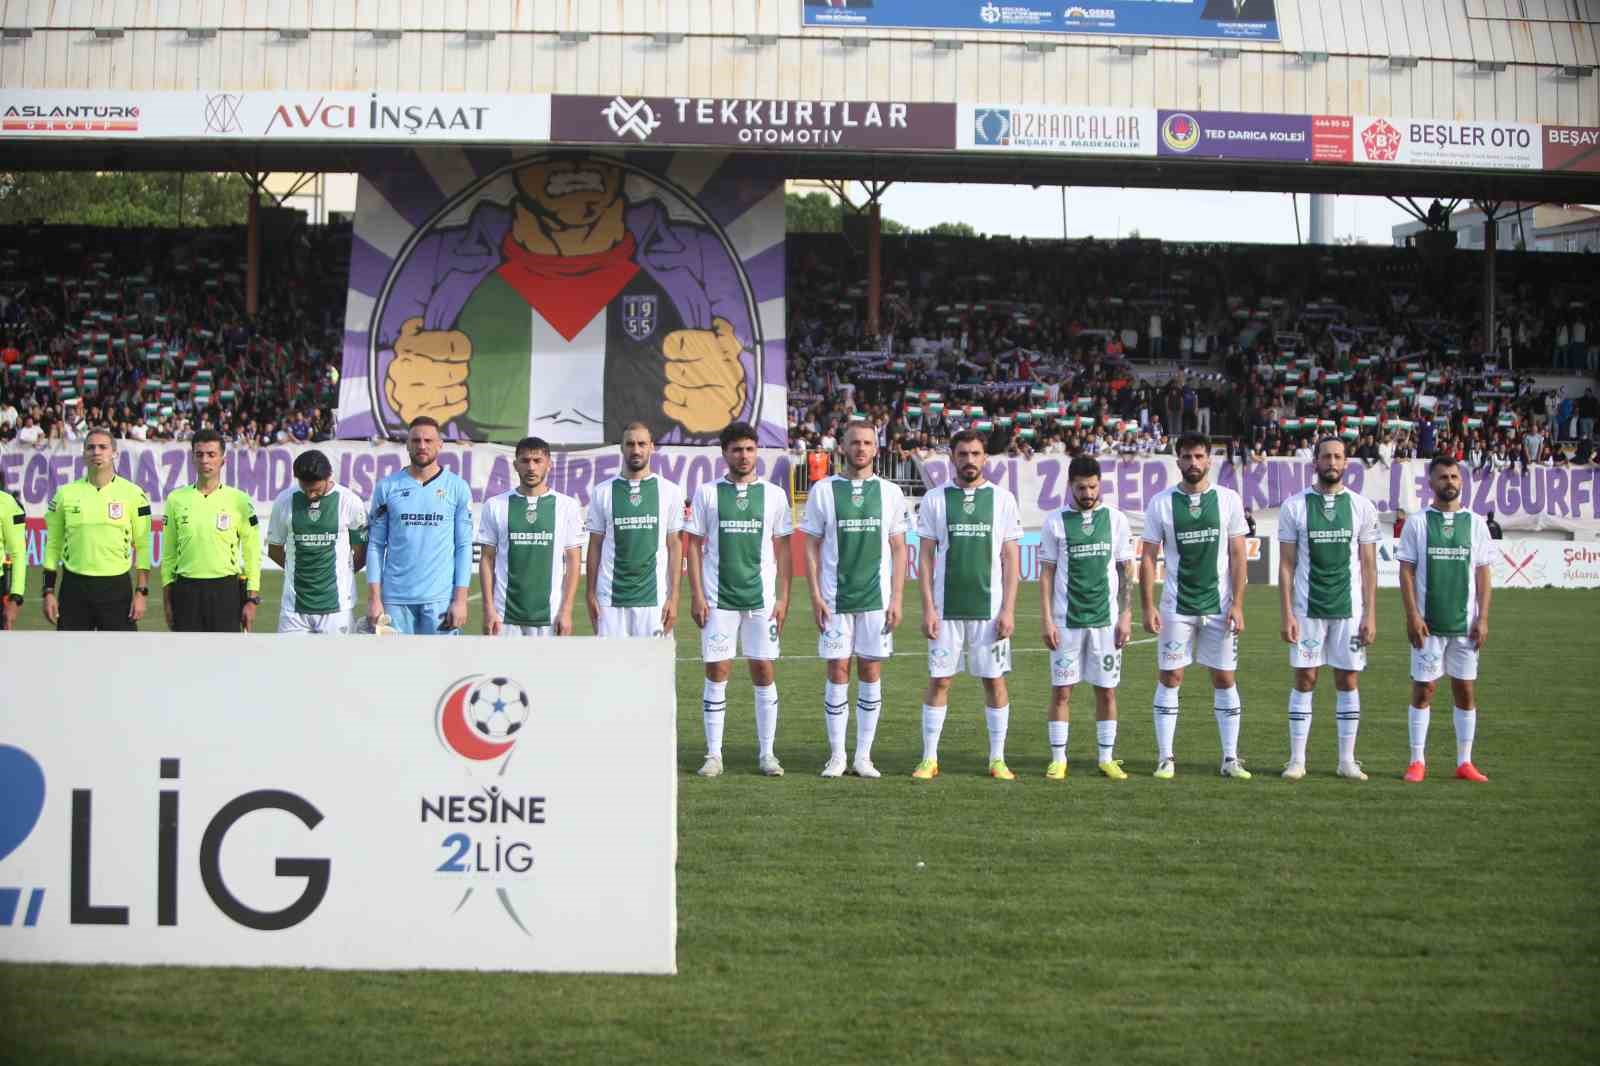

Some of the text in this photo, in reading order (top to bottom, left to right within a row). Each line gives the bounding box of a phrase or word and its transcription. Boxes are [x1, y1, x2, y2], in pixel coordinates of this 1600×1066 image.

[264, 93, 489, 135] AVCI İNŞAAT
[674, 98, 908, 128] TEKKURTLAR
[1204, 128, 1227, 140] TED
[1410, 124, 1530, 149] BEŞLER OTO
[420, 785, 546, 824] NESİNE
